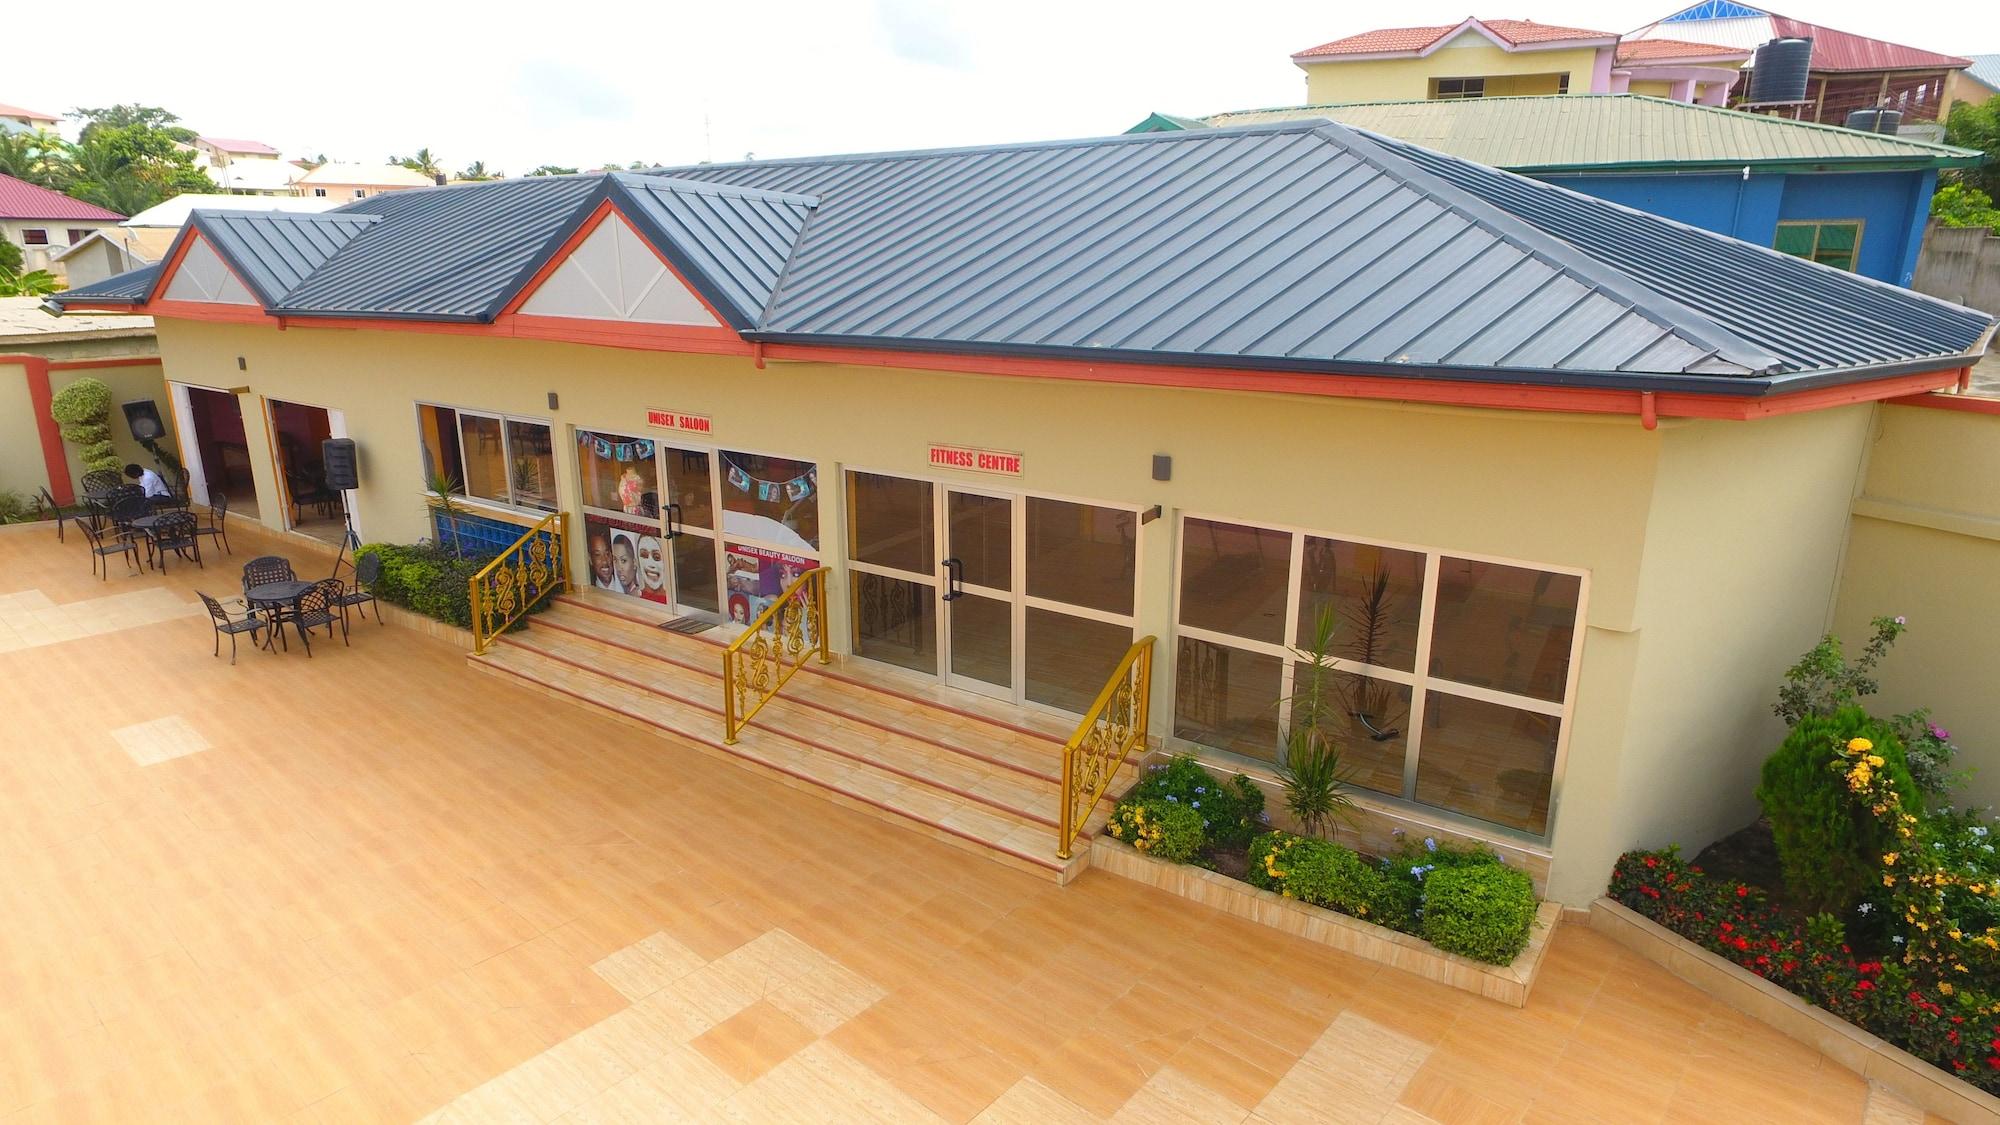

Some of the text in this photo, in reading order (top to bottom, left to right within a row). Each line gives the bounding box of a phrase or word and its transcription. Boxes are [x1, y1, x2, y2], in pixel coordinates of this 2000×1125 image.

[648, 411, 710, 432] UNISEX SALOON
[930, 448, 1020, 473] FITNESS CENTRE
[758, 549, 781, 560] BEAUTY
[781, 553, 805, 565] SALOON
